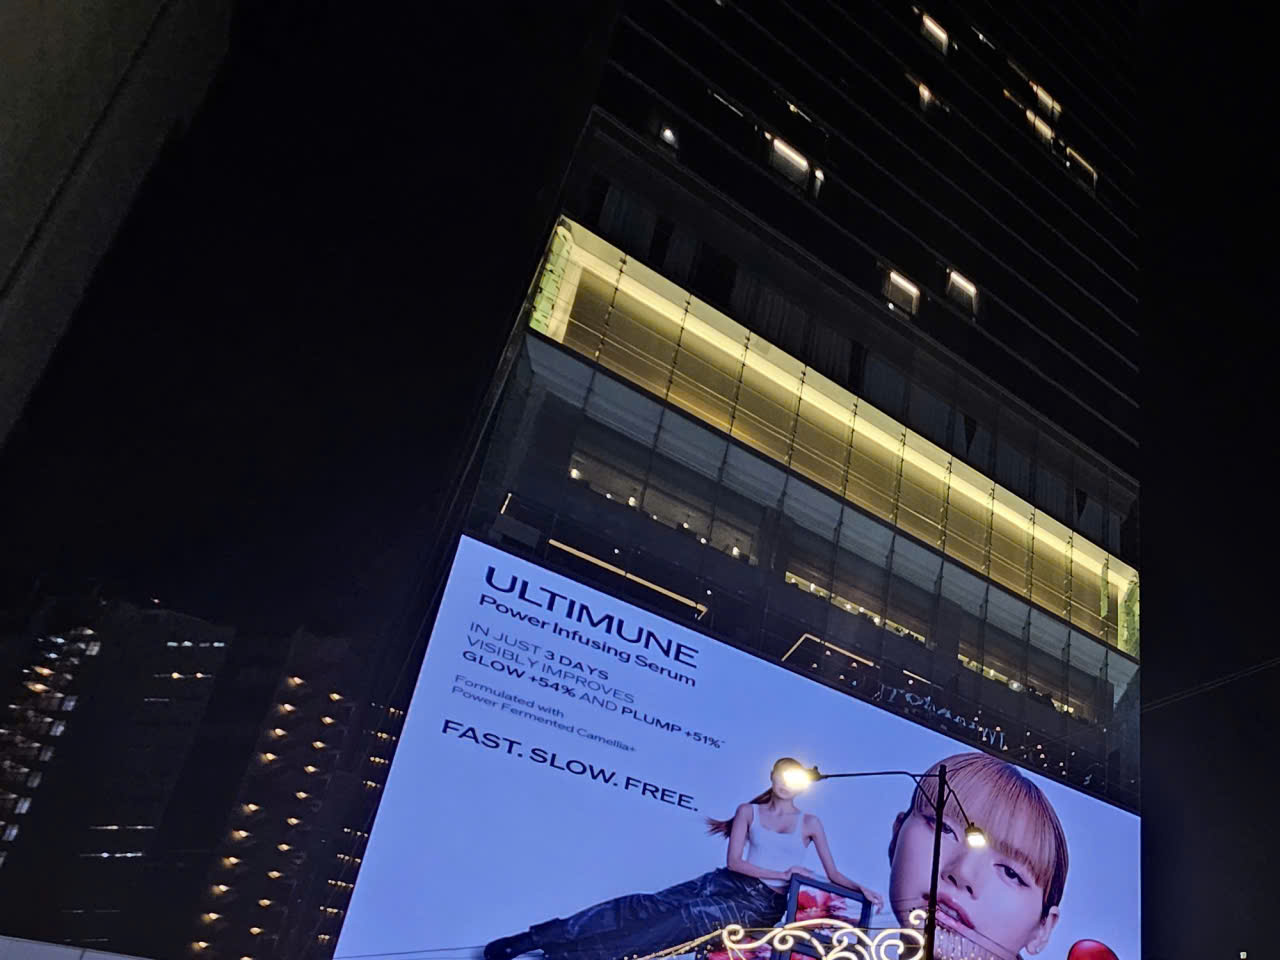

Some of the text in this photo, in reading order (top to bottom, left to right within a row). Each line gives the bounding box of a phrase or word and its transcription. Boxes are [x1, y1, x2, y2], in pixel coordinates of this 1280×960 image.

[470, 621, 609, 681] IN JUST 3 DAYS
[479, 593, 696, 687] Power Infusing Serum
[484, 565, 699, 669] ULTIMUNE
[454, 674, 565, 718] Formulated with
[462, 650, 525, 679] GLOW
[528, 673, 577, 698] +54%
[579, 691, 618, 712] AND
[621, 706, 682, 733] PLUMP
[467, 635, 635, 704] VISIBLY IMPROVES
[451, 686, 499, 708] Power
[501, 702, 575, 733] Fermented
[441, 719, 698, 812] FAST. SLOW. FREE.
